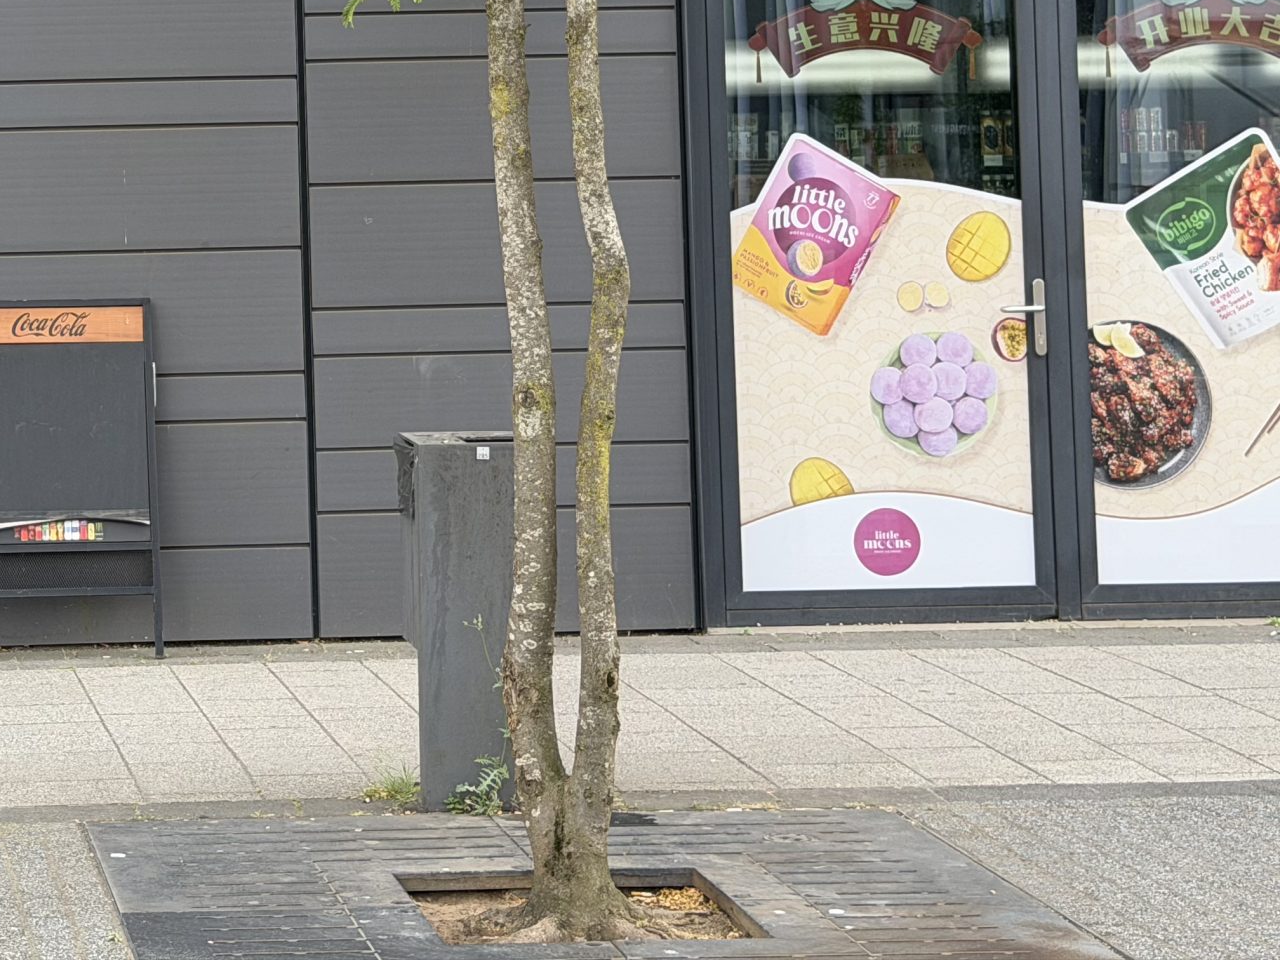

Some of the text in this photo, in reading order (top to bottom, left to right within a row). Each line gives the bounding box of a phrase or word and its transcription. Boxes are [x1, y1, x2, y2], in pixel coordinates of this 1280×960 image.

[788, 12, 943, 55] 生意兴隆
[791, 184, 847, 214] little
[767, 204, 860, 248] moons
[1163, 208, 1211, 242] bibigo
[1193, 260, 1229, 287] Fried
[1202, 264, 1254, 298] Chicken
[11, 311, 92, 338] Coca-Cola
[863, 539, 912, 550] moons
[874, 530, 900, 540] little
